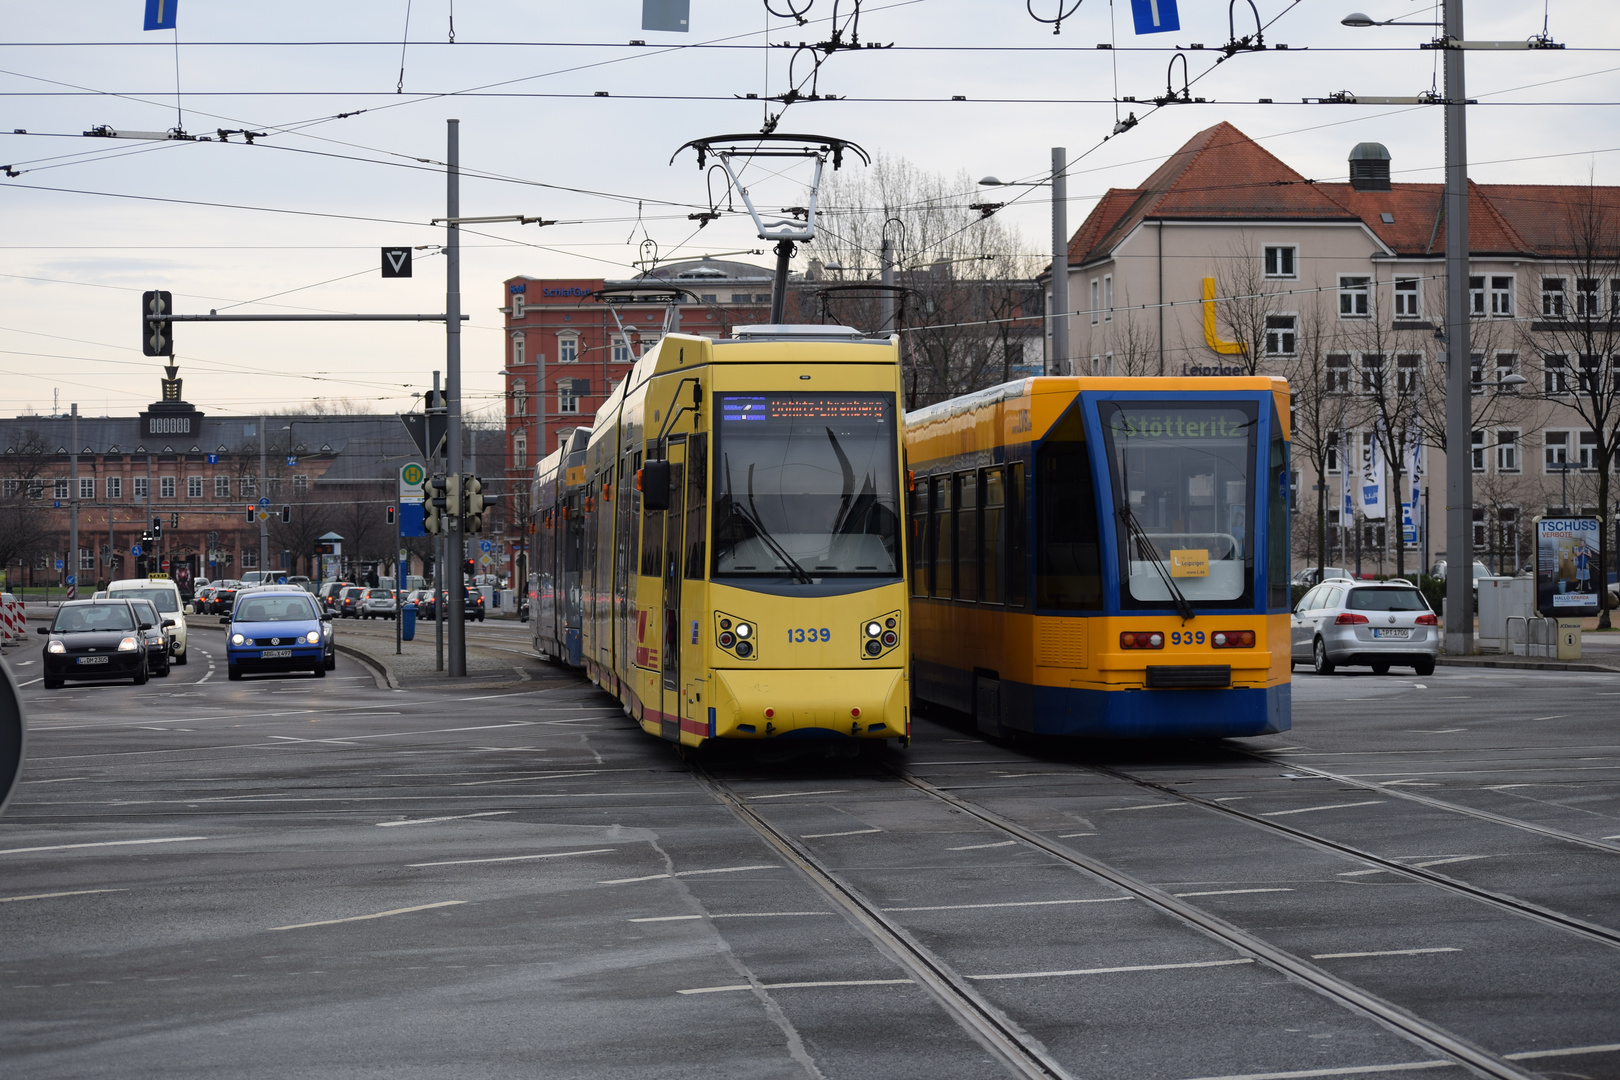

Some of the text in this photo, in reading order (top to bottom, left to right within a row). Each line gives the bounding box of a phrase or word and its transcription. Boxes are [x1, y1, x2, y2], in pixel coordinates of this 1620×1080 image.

[510, 283, 526, 294] Hotel
[543, 287, 591, 297] SchlafGut
[1203, 277, 1248, 354] L
[1183, 363, 1247, 376] Leipziger
[1125, 415, 1241, 437] Stötteritz
[408, 469, 418, 481] H
[1541, 518, 1597, 531] TSCHÜSS
[787, 628, 831, 643] 1339
[1171, 631, 1205, 645] 939
